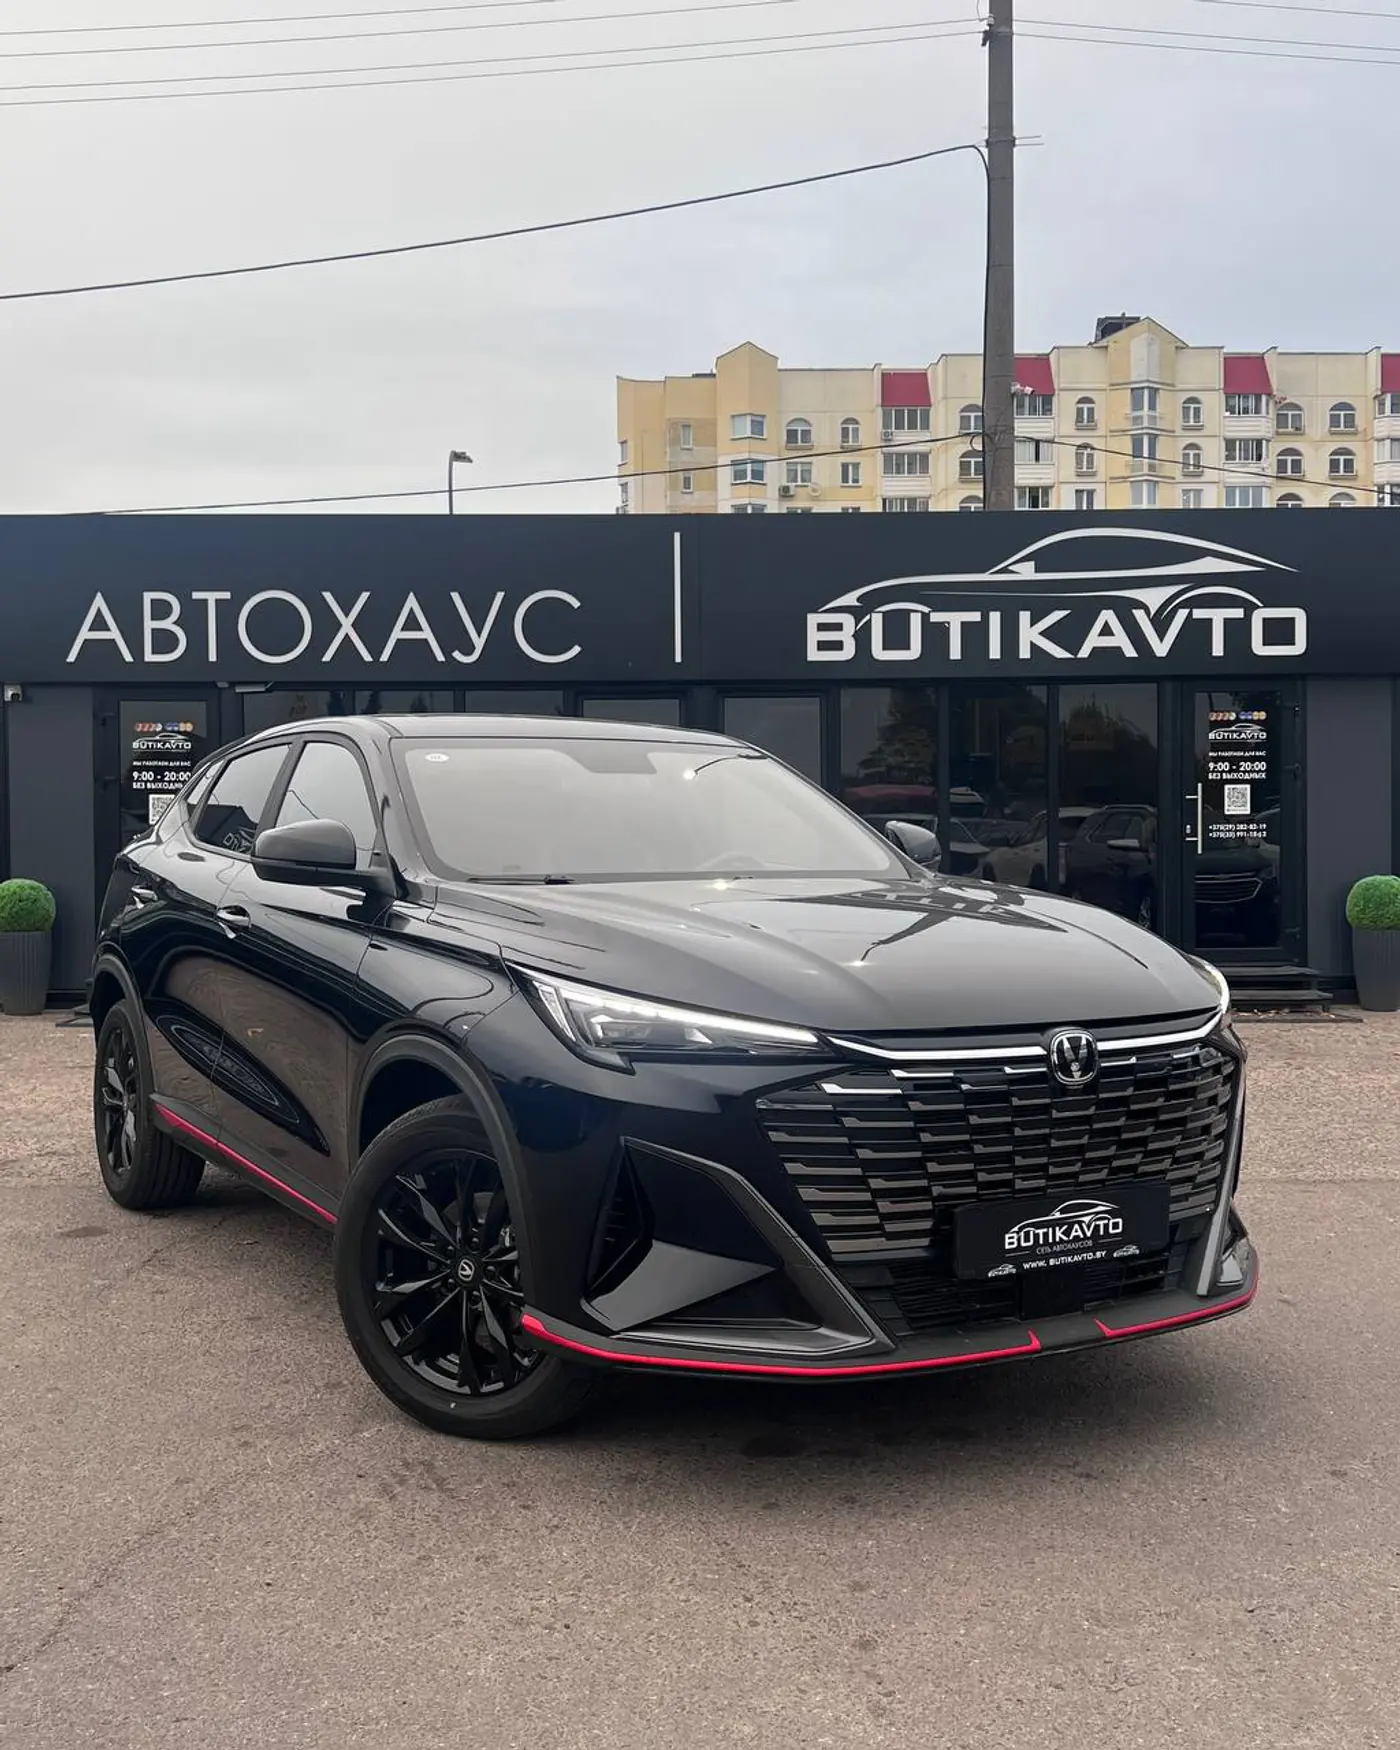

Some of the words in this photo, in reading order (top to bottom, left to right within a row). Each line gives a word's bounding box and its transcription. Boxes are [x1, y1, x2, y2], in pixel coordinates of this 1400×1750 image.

[66, 589, 583, 664] АВТОХАУС
[806, 605, 1308, 662] BUTIKAVTO
[1208, 731, 1267, 740] BUTIKAVTO
[132, 741, 192, 750] BUTIKAVTO
[1208, 762, 1230, 771] 9:00
[1239, 762, 1267, 771] 20:00
[132, 771, 155, 781] 9:00
[163, 771, 191, 781] 20:00
[1222, 772, 1267, 780] ВЫХОДНЫХ
[146, 782, 183, 790] ВЫХОДН
[1005, 1217, 1123, 1249] BUTIKAVTO
[1036, 1245, 1052, 1255] СЕТЬ
[1052, 1239, 1093, 1252] АВТОХАУСОВ
[1022, 1260, 1047, 1270] WWW.
[1049, 1250, 1107, 1266] BUTIKAVTO.BY
